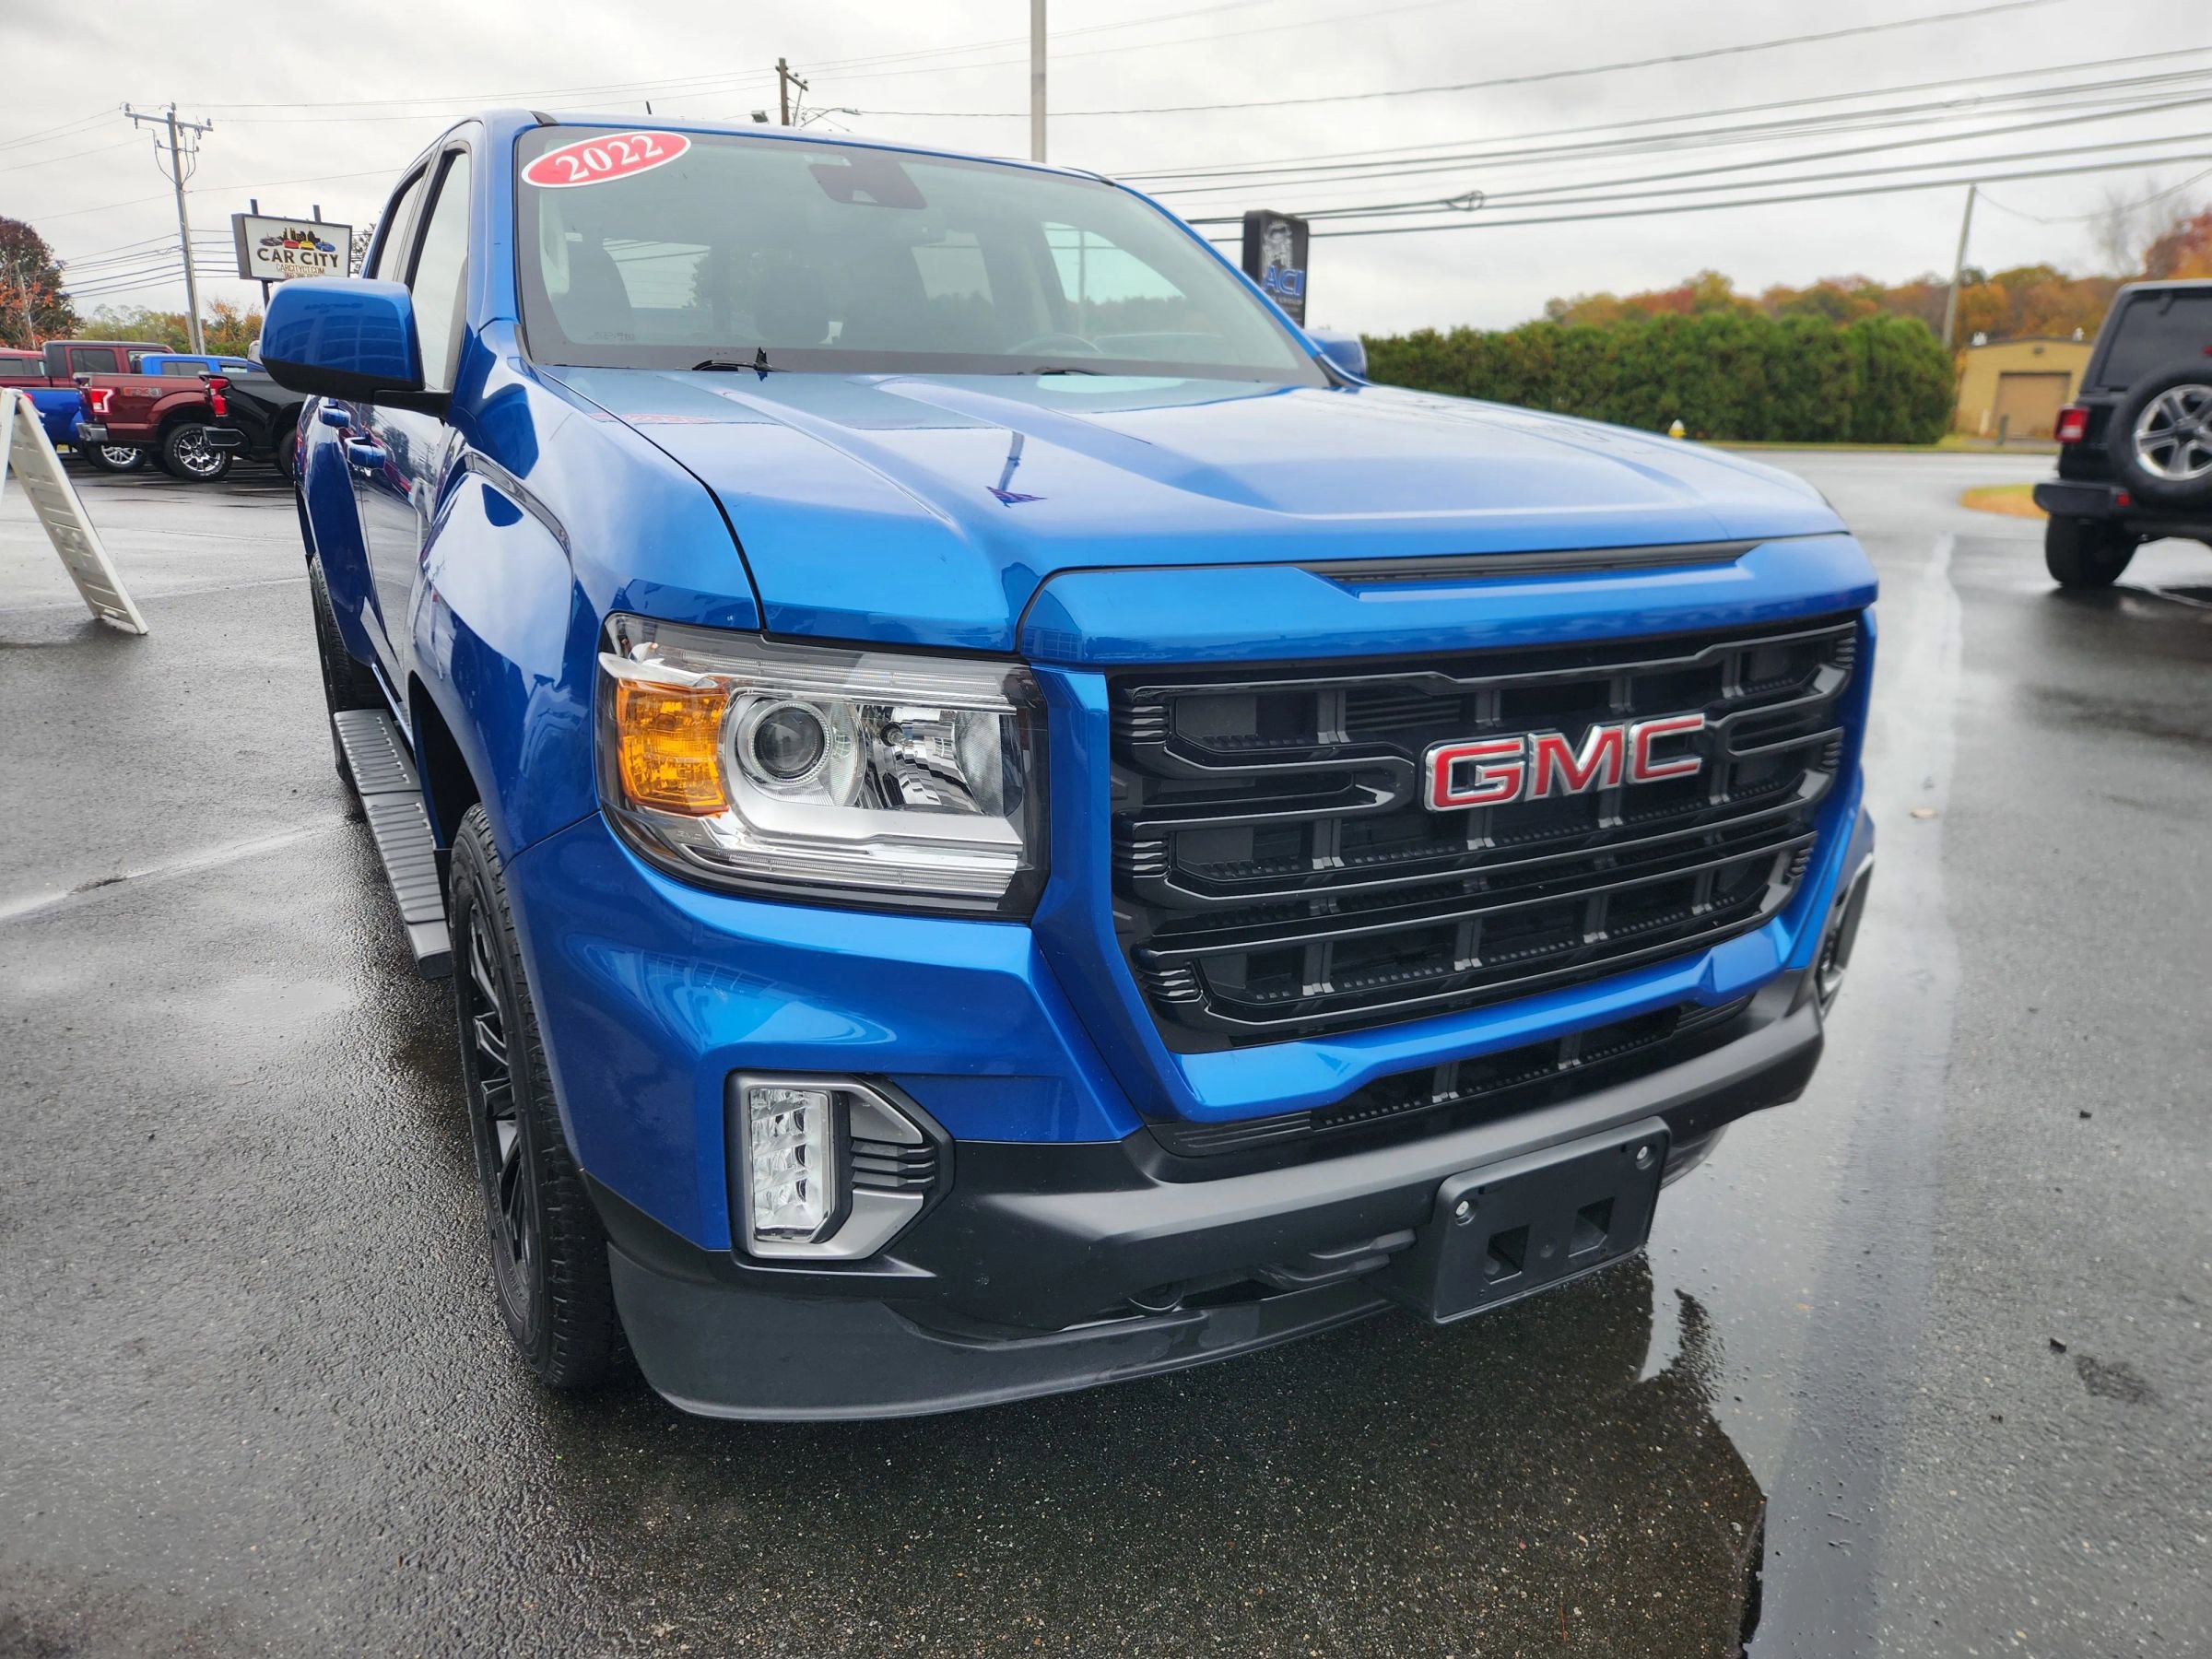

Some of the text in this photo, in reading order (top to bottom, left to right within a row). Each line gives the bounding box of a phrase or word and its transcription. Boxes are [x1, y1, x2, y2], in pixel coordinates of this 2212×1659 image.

[555, 135, 665, 182] 2022
[256, 247, 339, 268] CAR CITY
[1263, 265, 1303, 296] ACI
[1424, 712, 1705, 812] GMC
